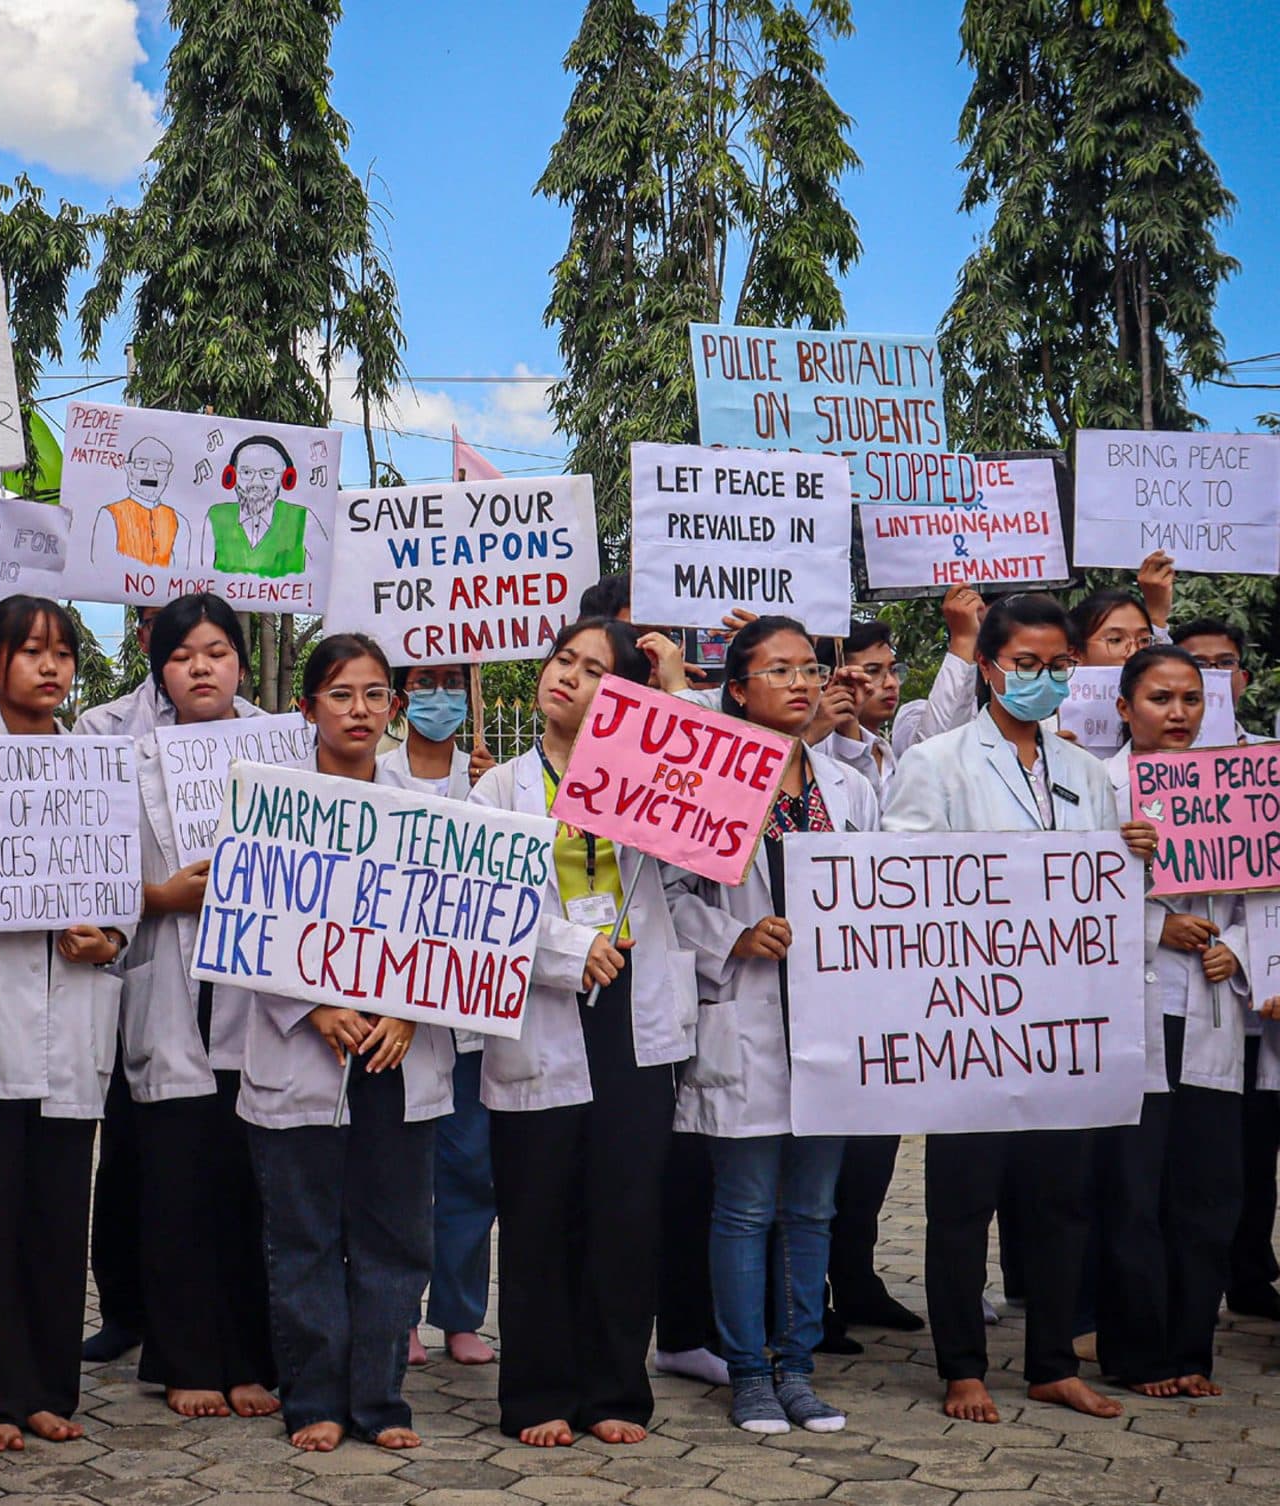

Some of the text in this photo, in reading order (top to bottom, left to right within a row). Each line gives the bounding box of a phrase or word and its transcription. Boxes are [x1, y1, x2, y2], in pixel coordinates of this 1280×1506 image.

[701, 334, 935, 388] POLICE BRUTALITY
[71, 407, 124, 431] PEOPLE
[753, 392, 942, 445] ON STUDENTS
[84, 432, 118, 448] LIFE
[1107, 442, 1251, 471] BRING PEACE
[655, 465, 700, 495] LET
[713, 467, 785, 499] PEACE
[795, 470, 824, 501] BE
[866, 451, 977, 504] STOPPED
[1134, 478, 1233, 508] BACK TO
[348, 491, 554, 532] SAVE YOUR
[667, 512, 815, 544] PREVAILED IN
[875, 511, 1049, 542] LINTHOINGAMBI
[14, 528, 59, 554] FOR
[387, 527, 574, 569] WEAPONS
[953, 534, 969, 557] &
[1140, 520, 1237, 553] MANIPUR
[673, 563, 794, 604] MANIPUR
[933, 555, 1045, 584] HEMANJIT
[124, 573, 156, 597] NO
[226, 581, 313, 607] SILENCE!
[373, 572, 568, 614] FOR ARMED
[403, 613, 568, 659] CRIMINA
[591, 687, 786, 792] JUSTICE
[1084, 718, 1108, 735] ON
[93, 746, 131, 783] THE
[167, 737, 217, 774] STOP
[1136, 756, 1280, 795] BRING PEACE
[176, 778, 224, 813] AGAIN
[651, 762, 703, 798] FOR
[10, 789, 33, 827] OF
[40, 789, 109, 826] ARMED
[566, 767, 748, 858] 2 VICTIMS
[1171, 792, 1279, 827] BACK TO
[230, 779, 551, 885] UNARMED TEENAGERS
[47, 834, 133, 875] AGAINST
[1151, 831, 1280, 883] MANIPUR
[212, 834, 541, 947] CANNOT BE TREATED
[810, 850, 1126, 912] JUSTICE FOR
[1, 883, 94, 922] STUDENTS
[95, 881, 142, 917] RALLY
[195, 904, 530, 1020] LIKE CRIMINALS
[815, 913, 1120, 972] LINTHOINGAMBI
[925, 973, 1024, 1020] AND
[858, 1016, 1110, 1086] HEMANJIT
